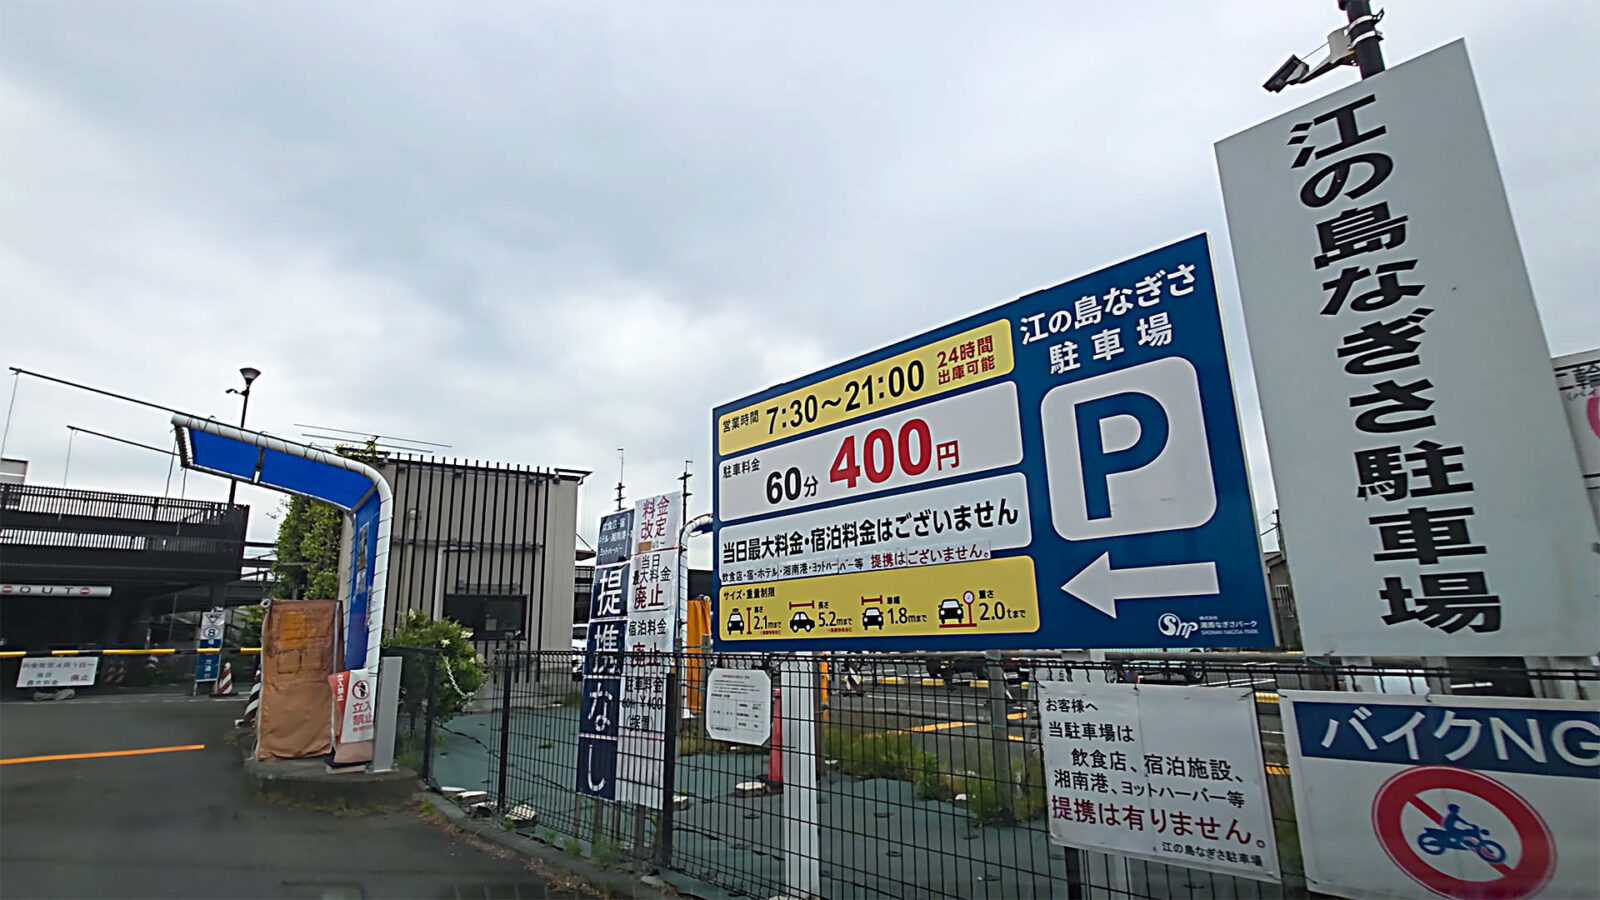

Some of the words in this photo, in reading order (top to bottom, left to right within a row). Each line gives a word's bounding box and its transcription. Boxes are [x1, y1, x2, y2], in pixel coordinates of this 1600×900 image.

[1020, 263, 1196, 345] 江の島なぎさ
[937, 335, 994, 369] 24時間
[1050, 312, 1173, 374] 駐車場
[938, 355, 996, 385] 出庫可能
[1287, 94, 1502, 635] 江の島なぎさ駐車場
[722, 409, 759, 433] 営業時間
[723, 458, 761, 479] 駐車料金
[766, 466, 819, 505] 60分
[829, 418, 959, 489] 400円
[1074, 391, 1170, 521] P
[642, 496, 670, 519] 料金
[641, 517, 667, 541] 改定
[723, 498, 1018, 564] 当日最大料金・宿泊料金はございません
[641, 554, 660, 569] 当日
[871, 543, 990, 568] 提携はございません。
[632, 566, 671, 586] 最大料金
[20, 585, 73, 595] OUT
[634, 583, 664, 609] 廃止
[723, 587, 775, 601] サイズ・重量制限
[629, 618, 667, 636] 宿泊料金
[352, 701, 372, 714] 立入
[1045, 699, 1099, 713] お客様へ
[1049, 722, 1135, 742] 当駐車場は
[1321, 706, 1600, 767] バイクNG
[1071, 748, 1243, 783] 飲食店、宿泊施設、
[1054, 769, 1245, 809] 湘南港、ヨットハーバー等
[1052, 795, 1266, 848] 提携は有りません。
[1162, 841, 1263, 867] 江の島なぎさ駐車場
